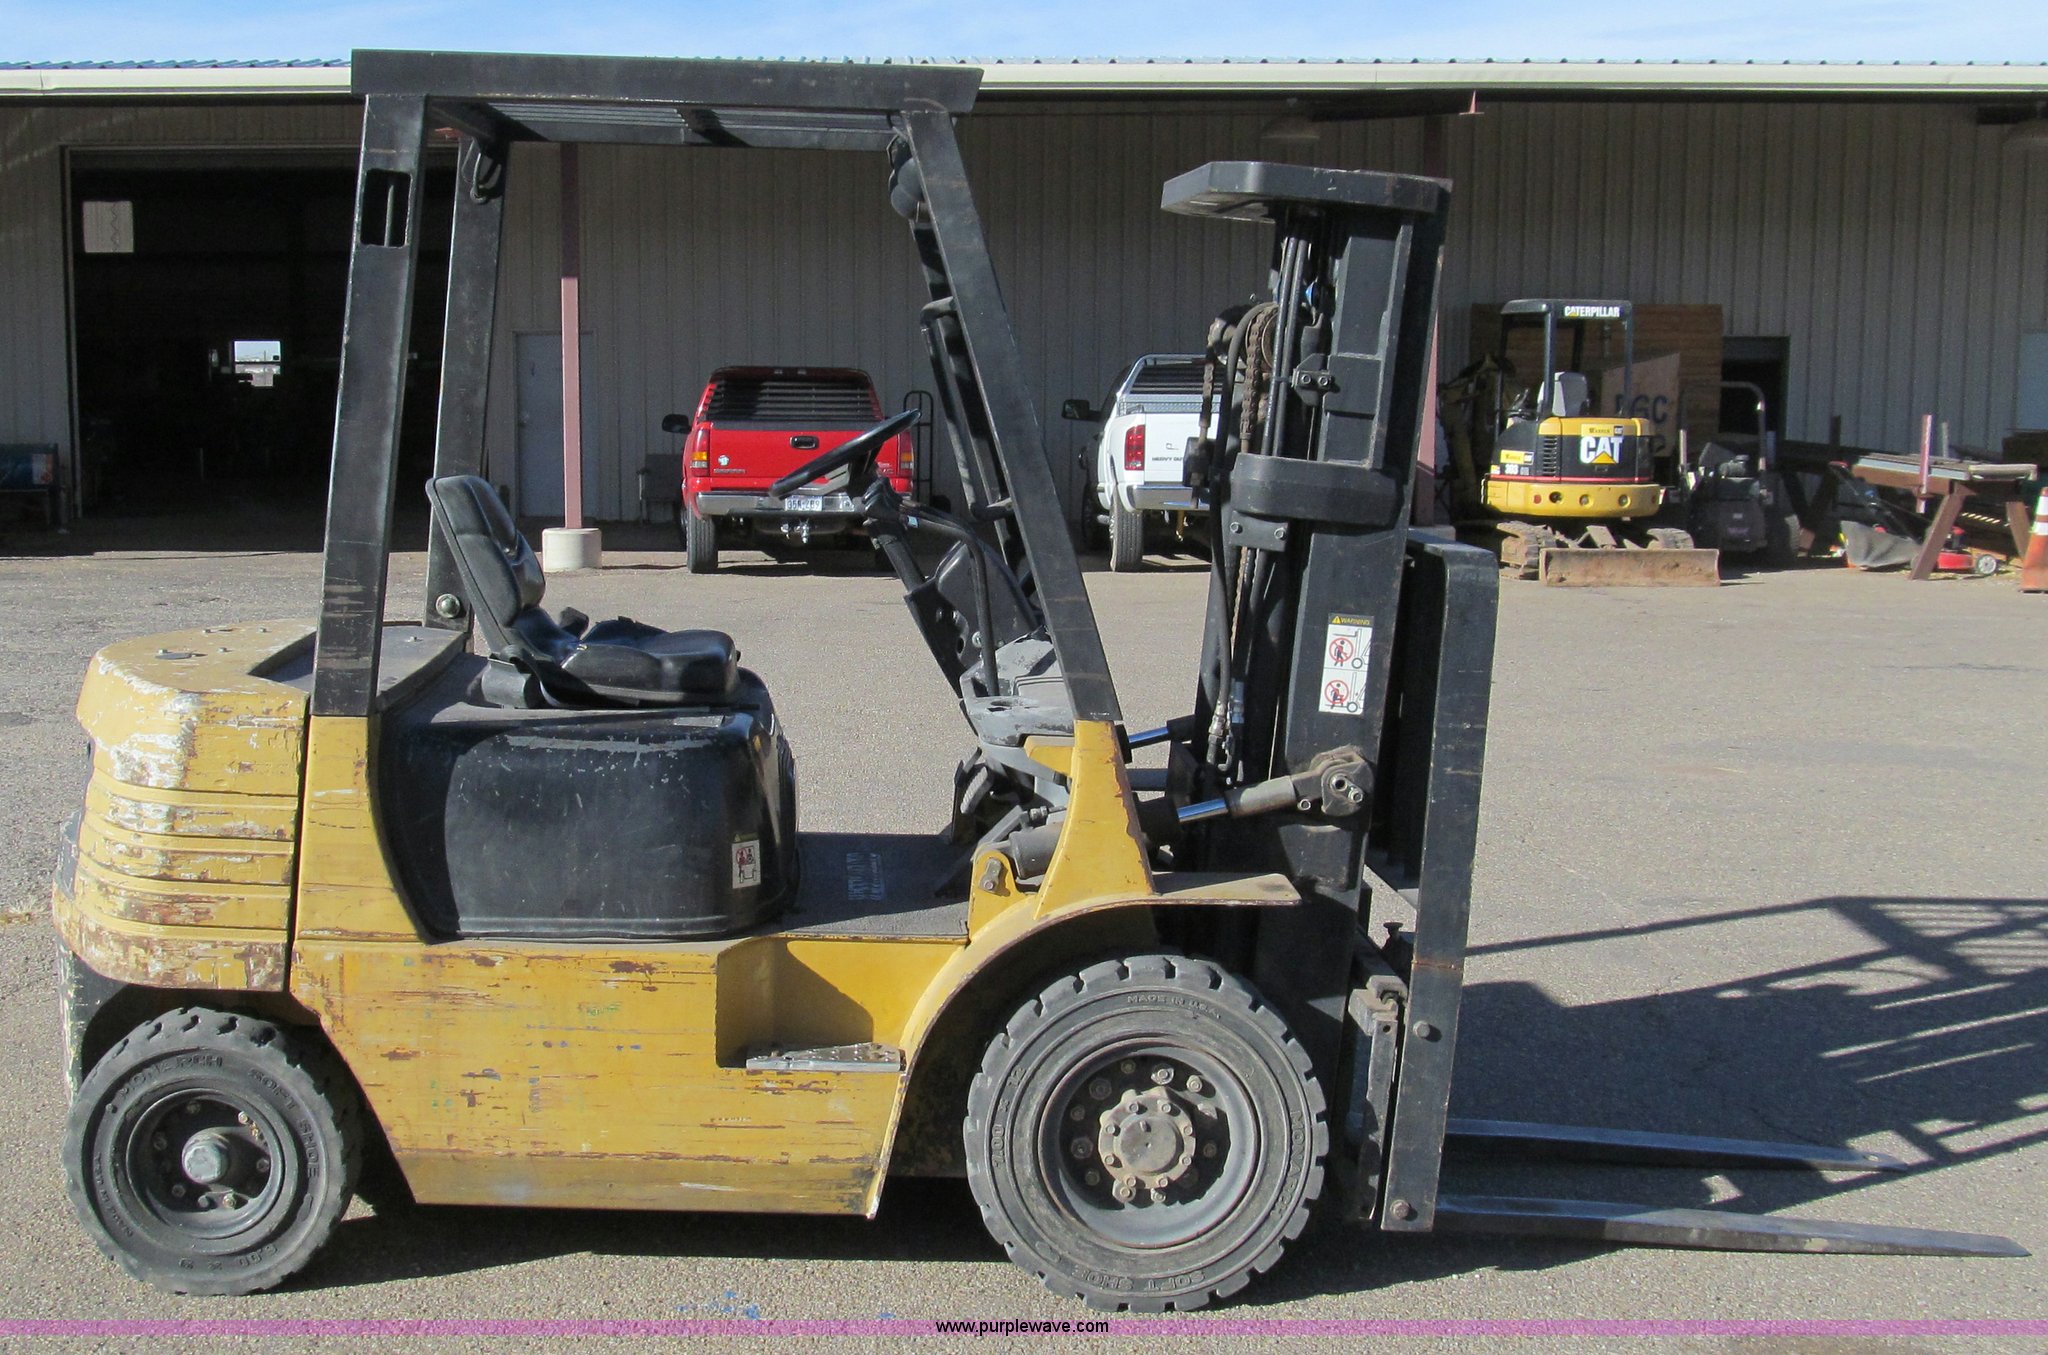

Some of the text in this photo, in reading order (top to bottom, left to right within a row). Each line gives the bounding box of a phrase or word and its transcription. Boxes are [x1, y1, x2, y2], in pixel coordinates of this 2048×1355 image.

[1564, 306, 1620, 317] CATERPILLAR
[1580, 437, 1623, 464] CAT
[1341, 617, 1370, 625] WARNING
[1127, 994, 1167, 1004] MADE
[1171, 996, 1186, 1006] IN
[118, 1055, 223, 1097] MONARCH
[298, 1119, 320, 1178] SHOE
[1270, 1110, 1305, 1220] MONARCH
[1144, 1270, 1205, 1291] SOFT
